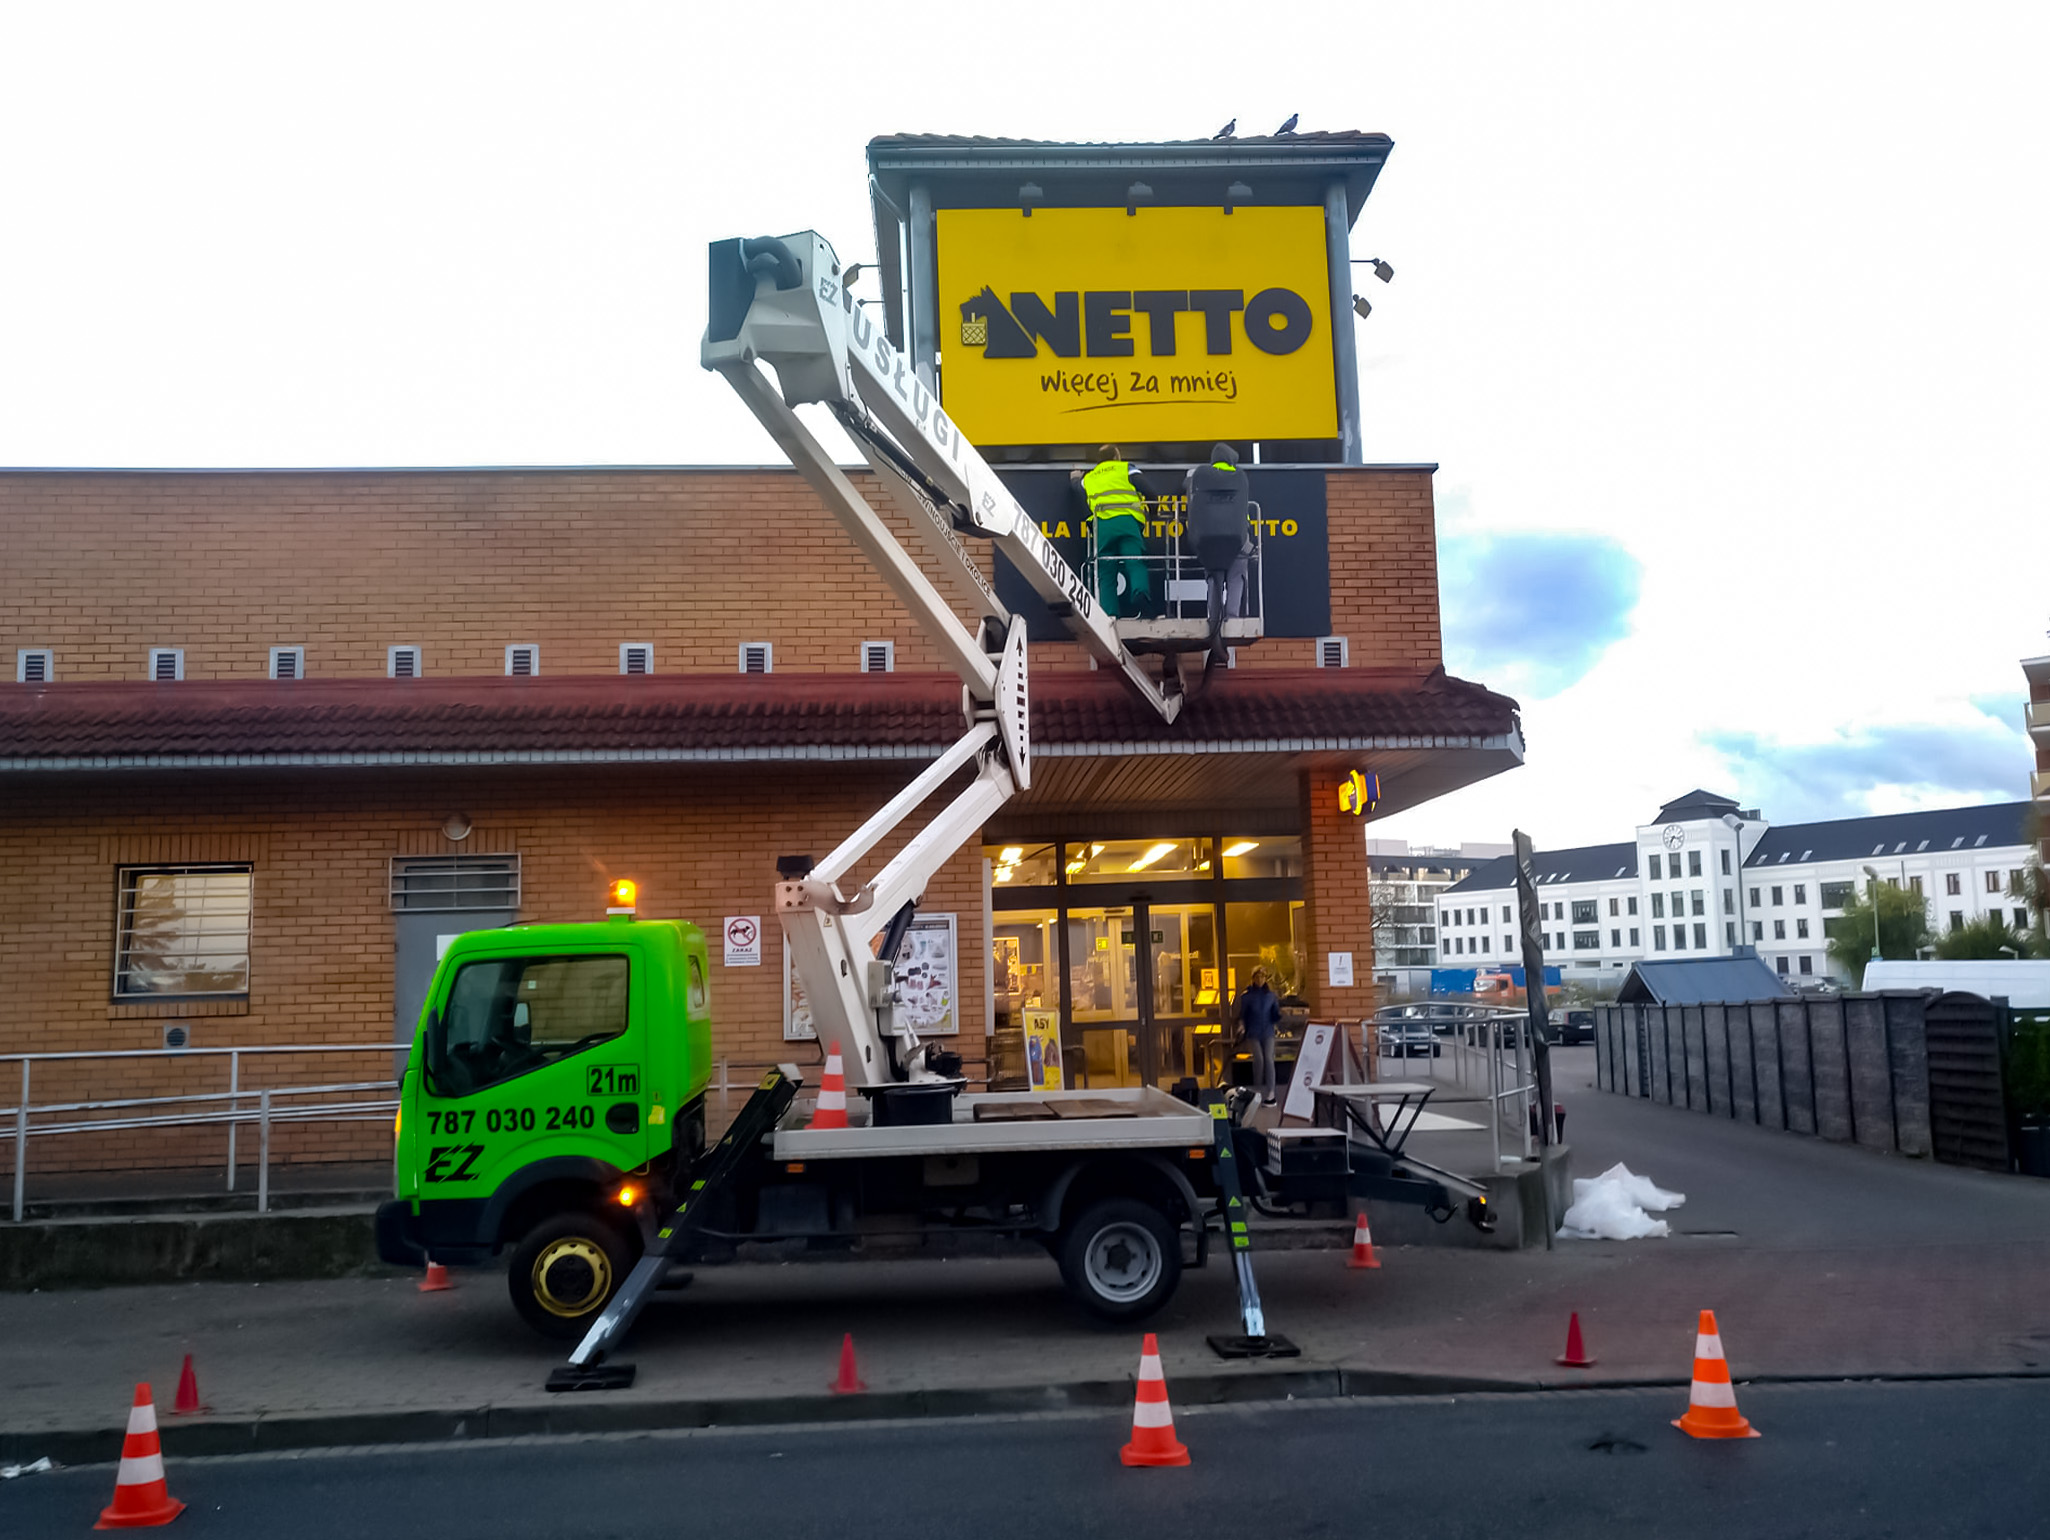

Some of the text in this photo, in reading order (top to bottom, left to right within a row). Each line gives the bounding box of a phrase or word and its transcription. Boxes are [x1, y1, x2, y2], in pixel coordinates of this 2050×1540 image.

[1009, 286, 1314, 359] NETTO
[852, 302, 960, 462] USŁUGI
[1170, 370, 1238, 400] mniej
[1034, 520, 1071, 538] LA
[1249, 518, 1299, 537] TTO
[1012, 501, 1092, 620] 787 030 240
[589, 1067, 638, 1094] 21m
[426, 1104, 595, 1135] 787 030 240
[423, 1141, 486, 1184] EZ
